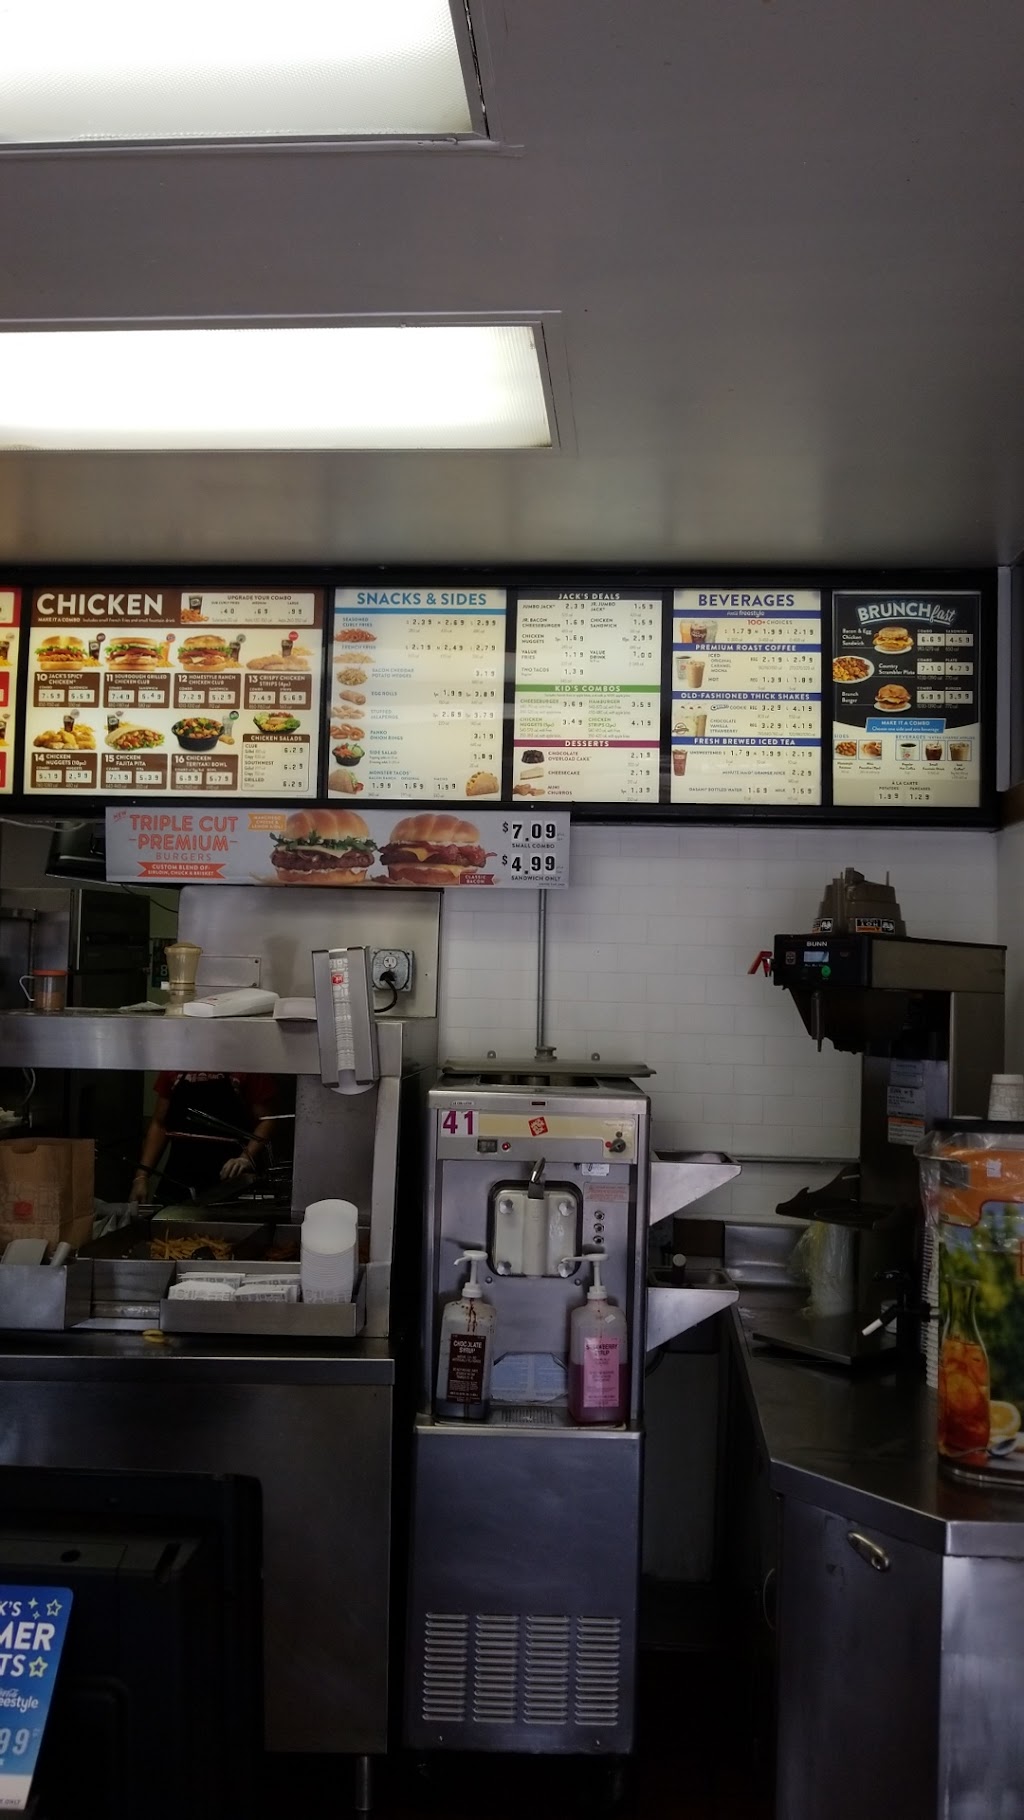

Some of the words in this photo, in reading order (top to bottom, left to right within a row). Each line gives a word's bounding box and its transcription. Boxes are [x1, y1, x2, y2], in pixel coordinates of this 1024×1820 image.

[357, 592, 421, 605] SNACKS
[426, 593, 437, 605] &
[441, 593, 486, 605] SIDES
[698, 594, 795, 607] BEVERAGES
[36, 593, 163, 616] CHICKEN
[739, 610, 765, 618] freestyle
[106, 674, 113, 682] 11
[248, 675, 258, 683] 13
[842, 697, 858, 705] Burger
[34, 754, 45, 762] 14
[175, 755, 185, 764] 16
[113, 811, 127, 820] NEW
[130, 814, 193, 832] TRIPLE
[199, 815, 238, 832] CUT
[138, 834, 229, 851] PREMIUM
[156, 852, 212, 861] BURGERS
[442, 1110, 474, 1135] 41
[586, 1343, 618, 1351] SWBERRY
